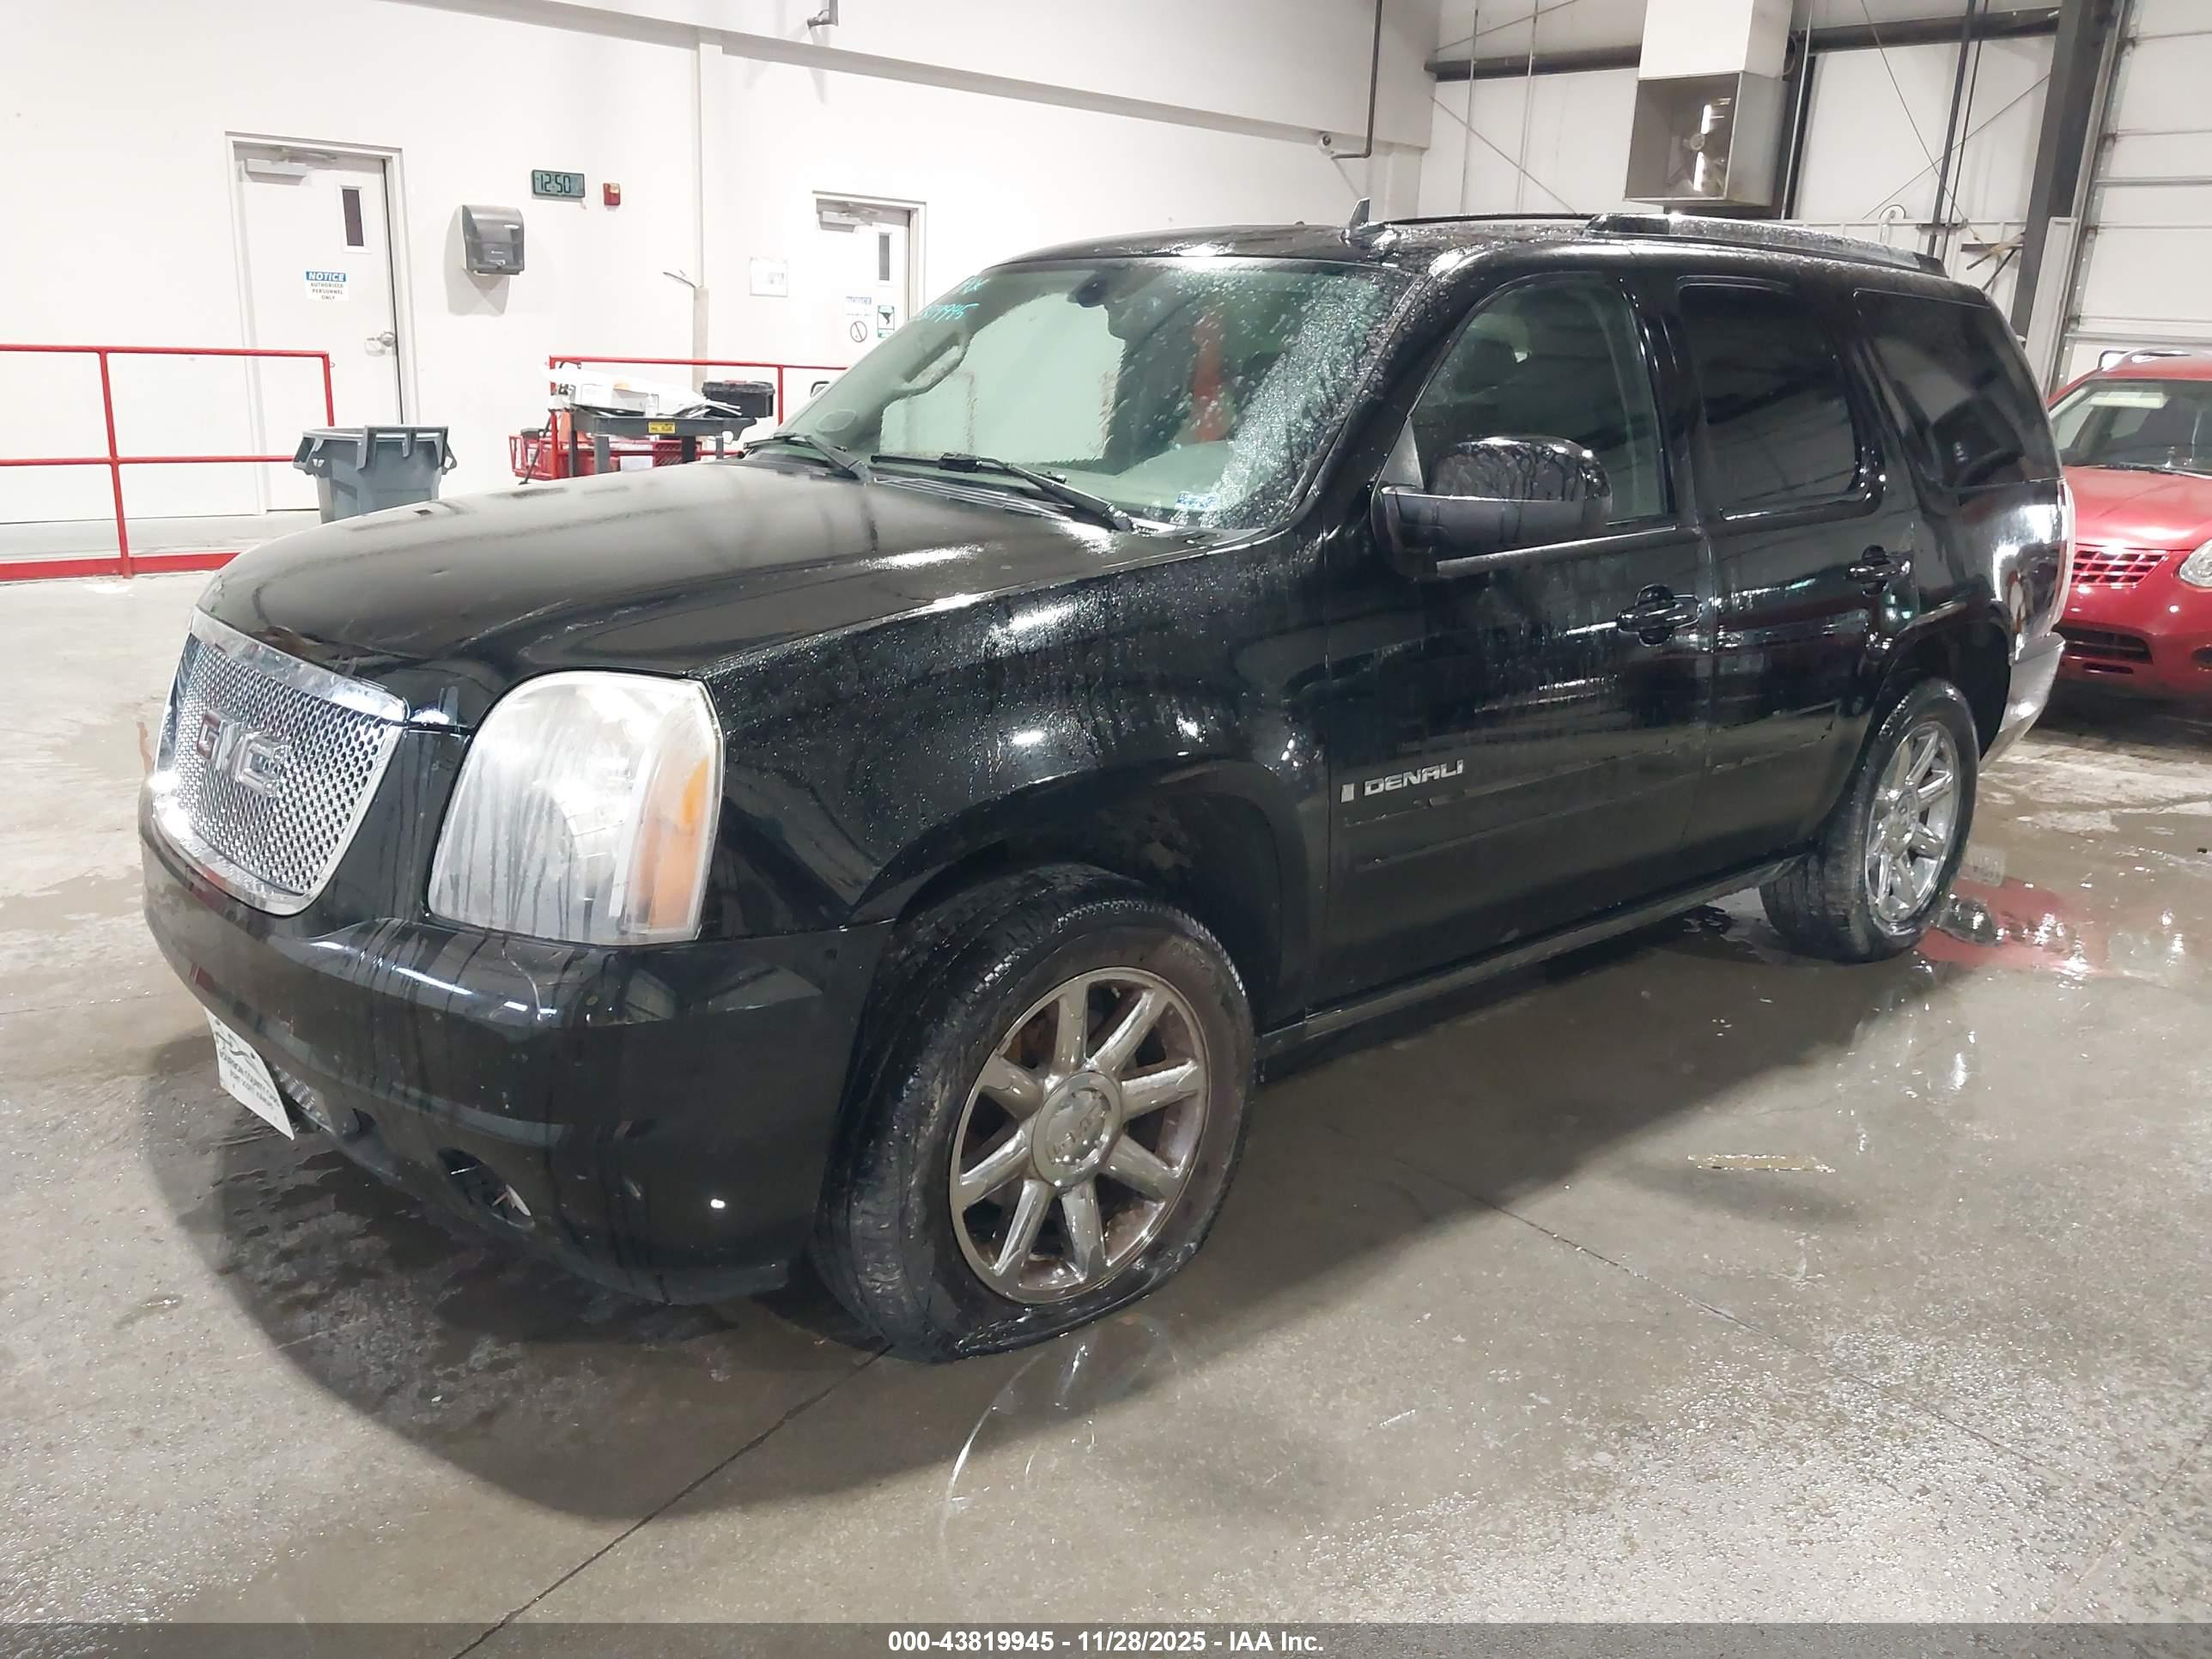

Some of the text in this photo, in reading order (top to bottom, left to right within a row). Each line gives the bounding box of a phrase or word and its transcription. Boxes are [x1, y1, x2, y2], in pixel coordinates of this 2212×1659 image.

[541, 173, 571, 194] 12:50
[308, 272, 345, 282] NOTICE
[197, 708, 279, 791] GMC
[1364, 759, 1464, 797] DENALI
